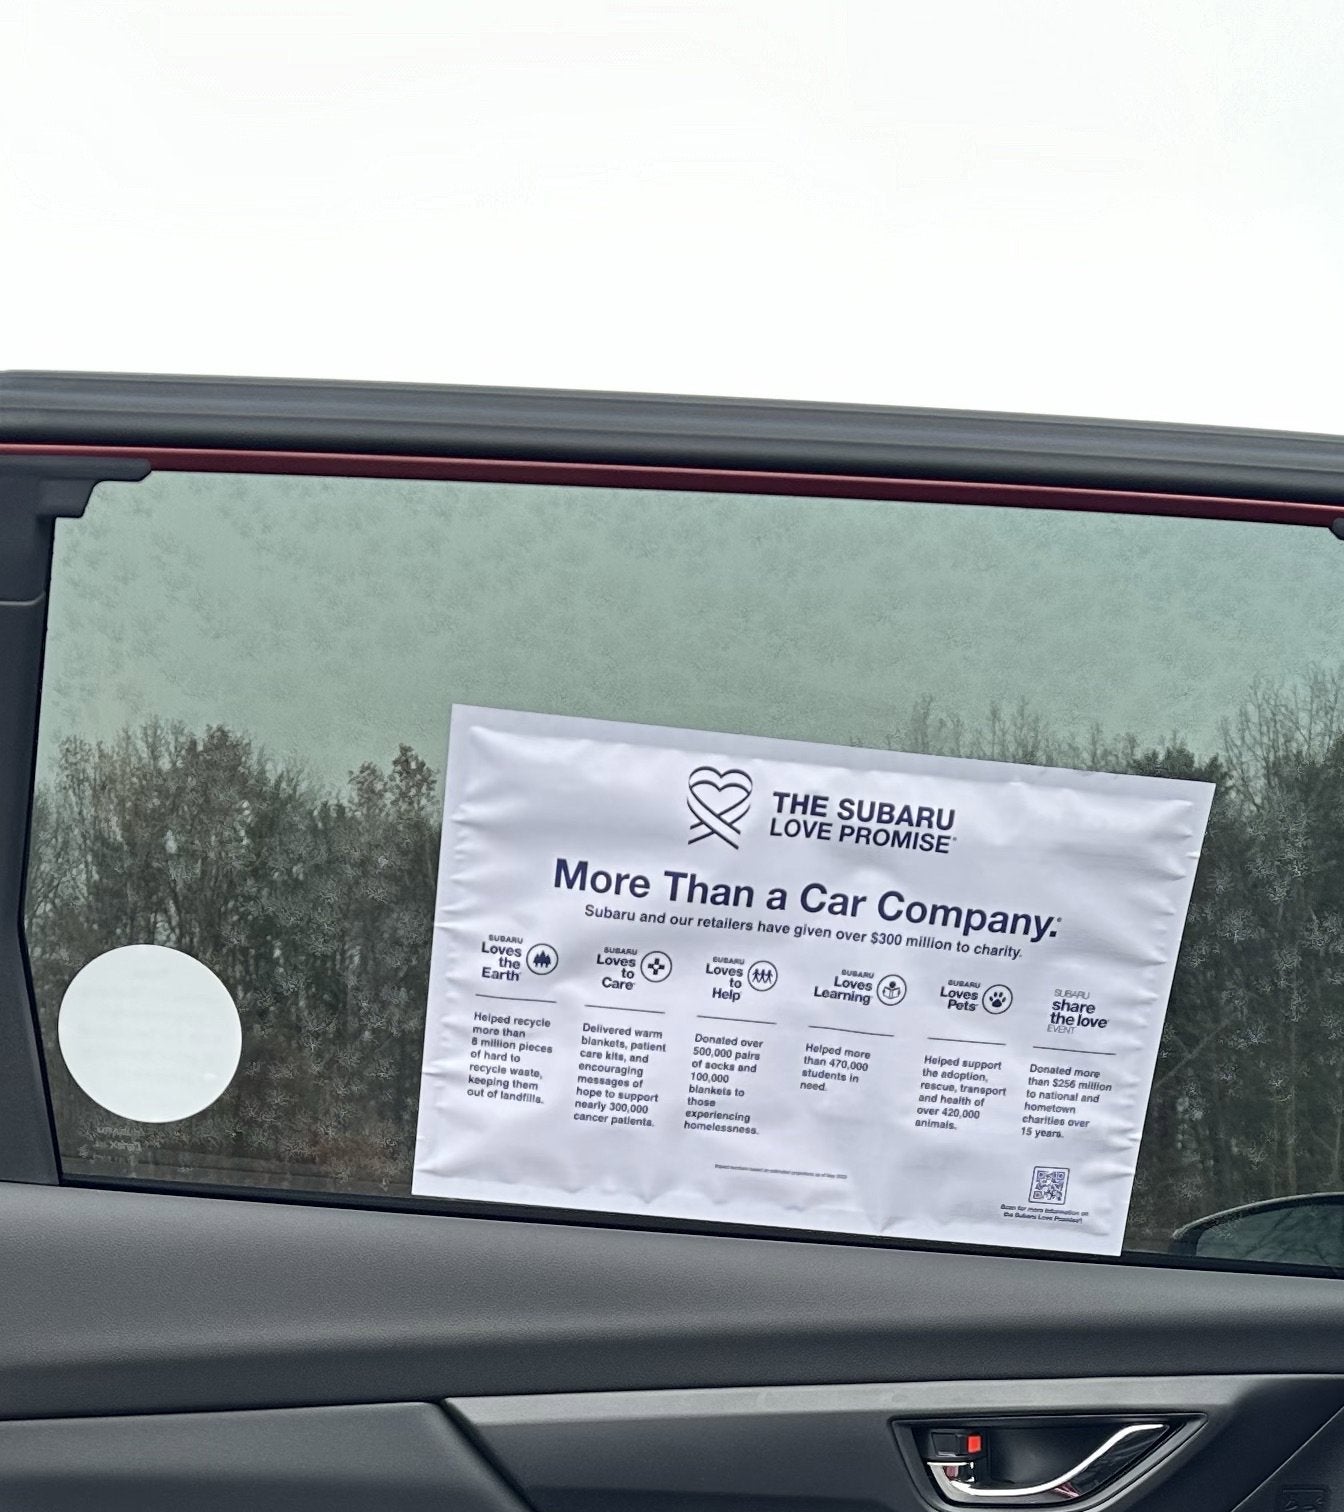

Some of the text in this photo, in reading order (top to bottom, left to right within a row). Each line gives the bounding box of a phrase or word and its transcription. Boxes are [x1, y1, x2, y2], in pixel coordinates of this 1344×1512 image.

[773, 791, 955, 831] THE SUBARU
[770, 817, 951, 854] LOVE PROMISE
[554, 858, 651, 899] More
[664, 870, 754, 908] Than
[766, 888, 787, 911] a
[800, 883, 867, 918] Car
[488, 934, 524, 945] SUBARU
[585, 904, 1022, 961] Subaru and our retailers have given over $300 million to charity.
[481, 941, 522, 958] Loves
[604, 946, 638, 956] SUBARU
[498, 956, 521, 970] the
[596, 953, 636, 968] Loves
[712, 956, 745, 966] SUBARU
[481, 966, 520, 982] Earth
[621, 968, 635, 980] to
[705, 963, 744, 978] Loves
[841, 969, 875, 979] SUBARU
[601, 976, 634, 991] Care
[729, 977, 742, 989] to
[834, 976, 873, 992] Loves
[947, 979, 981, 989] SUBARU
[712, 987, 741, 1003] Help
[813, 986, 872, 1006] Learning
[940, 986, 979, 1001] Loves
[1054, 988, 1090, 1000] SUBARU
[947, 998, 977, 1012] Pets
[1052, 999, 1096, 1014] share
[474, 1011, 551, 1029] Helped recycle
[1050, 1011, 1108, 1029] the love
[472, 1026, 526, 1039] more than
[583, 1022, 663, 1039] Delivered warm
[1046, 1024, 1077, 1035] EVENT
[480, 1038, 516, 1050] million
[518, 1042, 553, 1054] pieces
[630, 1042, 666, 1053] patient
[694, 1033, 764, 1048] Donated over
[470, 1049, 521, 1063] of hard to
[579, 1050, 603, 1060] care
[629, 1054, 649, 1064] and
[693, 1046, 761, 1061] 500,000 pairs
[805, 1043, 871, 1060] Helped more
[469, 1064, 507, 1075] recycle
[578, 1062, 644, 1078] encouraging
[691, 1059, 757, 1073] of socks and
[804, 1056, 869, 1072] than 470,000
[924, 1055, 1002, 1071] Helped support
[691, 1072, 730, 1084] 100,000
[802, 1068, 859, 1083] students in
[922, 1067, 939, 1078] the
[1029, 1063, 1101, 1079] Donated more
[468, 1075, 539, 1091] keeping them
[577, 1075, 644, 1088] messages of
[1028, 1077, 1050, 1087] than
[1078, 1081, 1113, 1092] million
[467, 1088, 485, 1098] out
[487, 1089, 499, 1099] of
[576, 1086, 659, 1103] hope to support
[688, 1084, 745, 1097] blankets to
[960, 1084, 1007, 1097] transport
[1026, 1089, 1101, 1103] to national and
[575, 1100, 649, 1114] nearly 300,000
[687, 1097, 716, 1107] those
[918, 1094, 985, 1107] and health of
[1024, 1101, 1076, 1114] hometown
[573, 1113, 609, 1123] cancer
[685, 1110, 751, 1124] experiencing
[916, 1107, 981, 1120] over 420,000
[1022, 1114, 1090, 1128] charities over
[1021, 1126, 1033, 1136] 15
